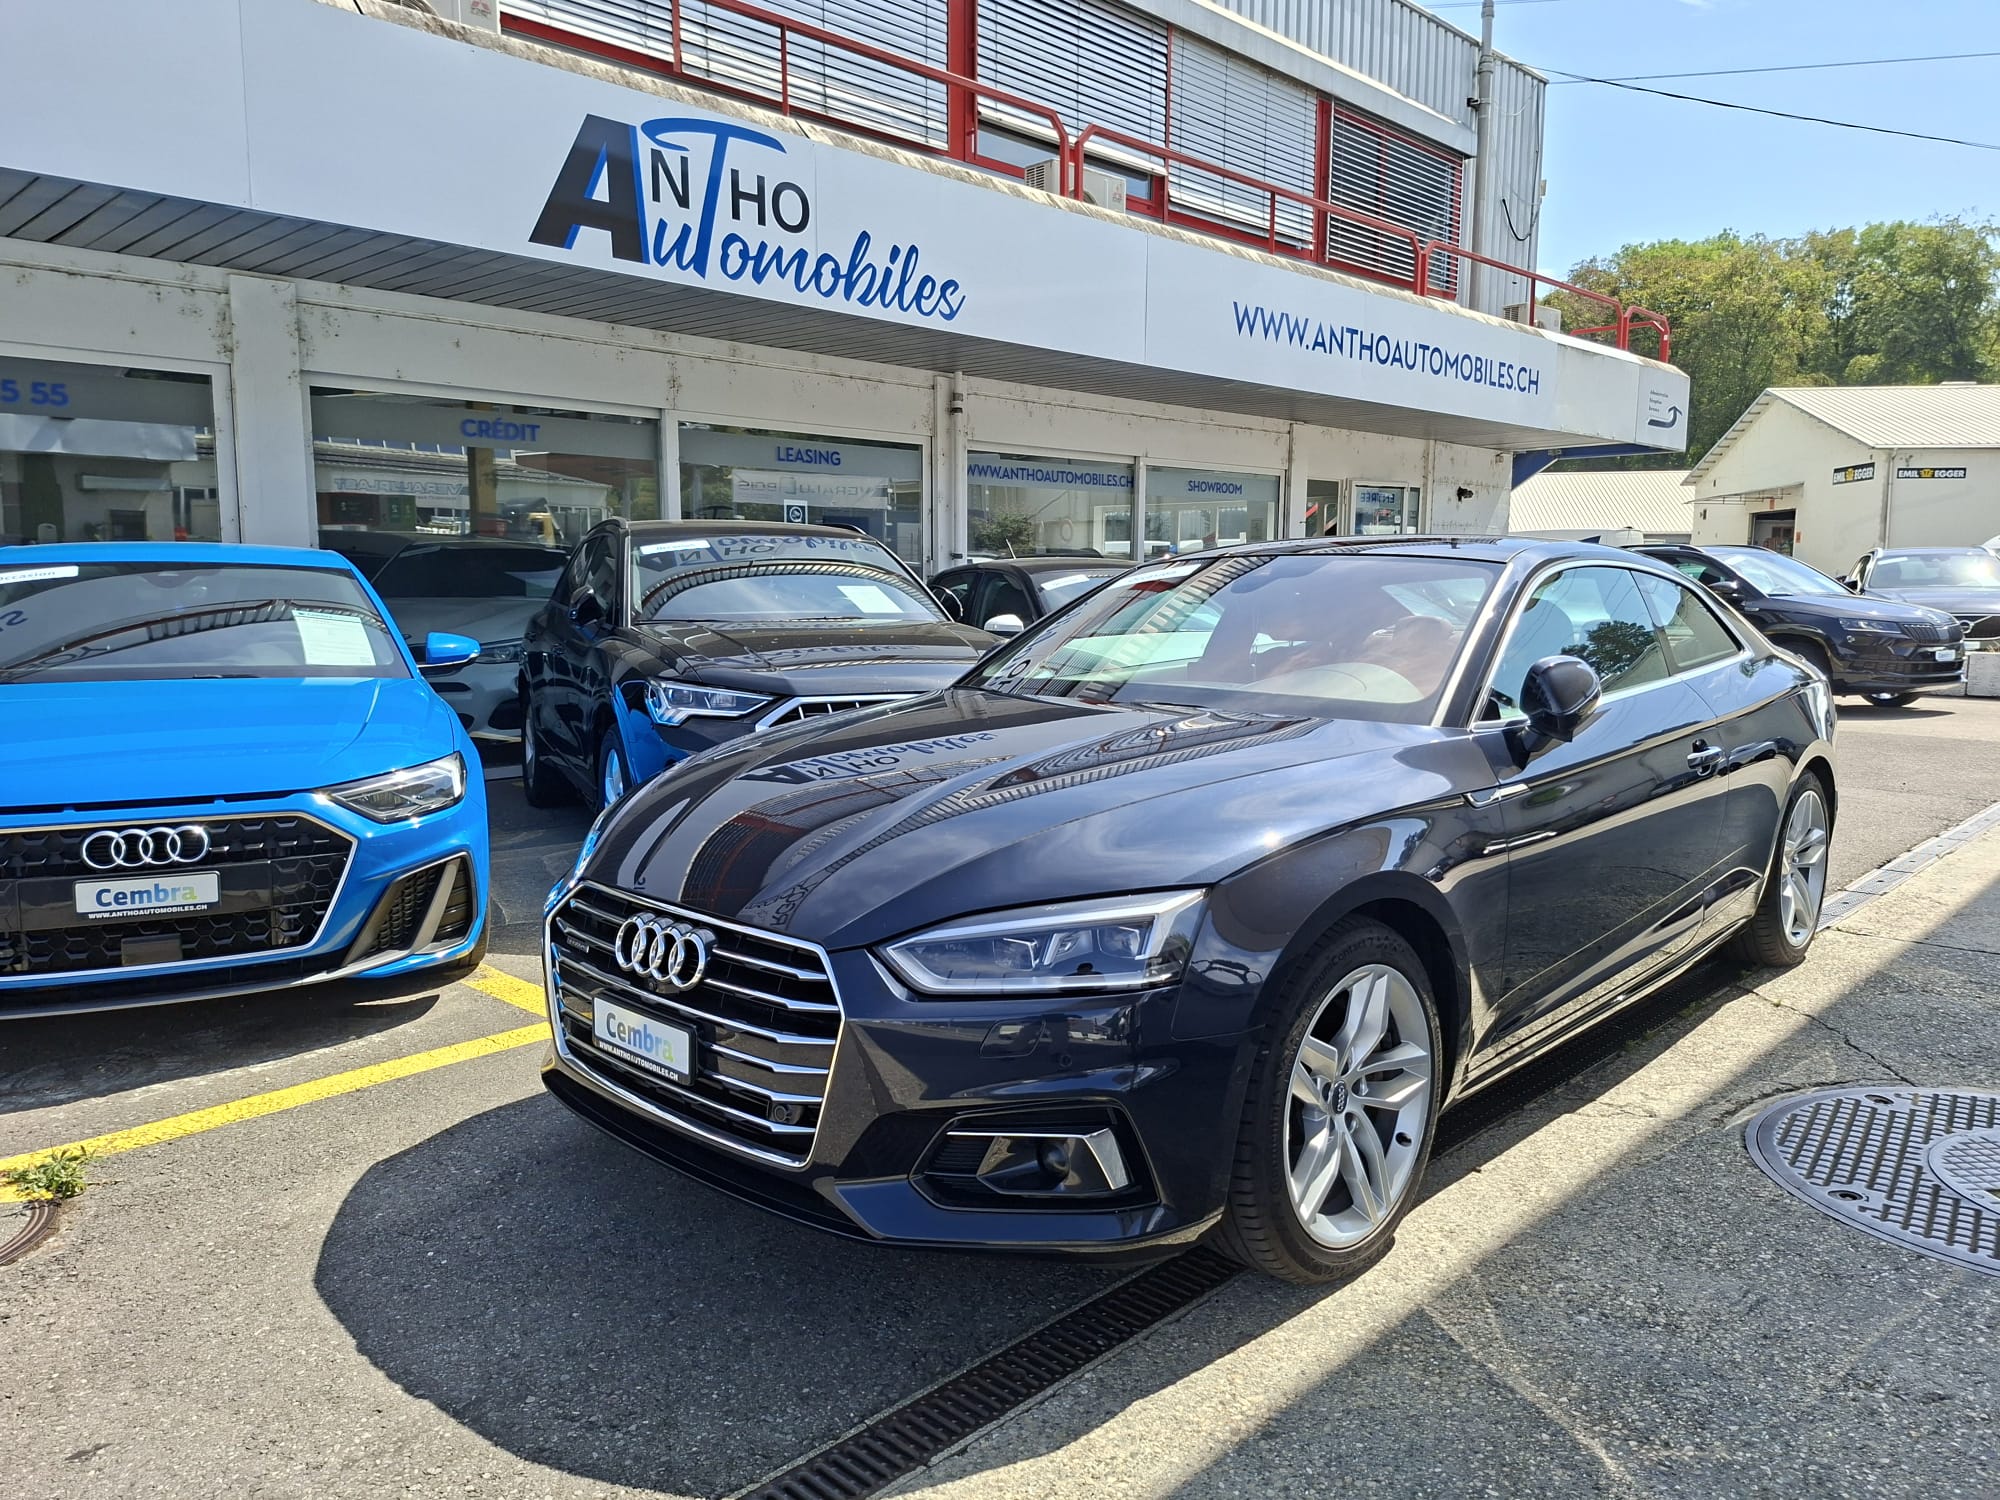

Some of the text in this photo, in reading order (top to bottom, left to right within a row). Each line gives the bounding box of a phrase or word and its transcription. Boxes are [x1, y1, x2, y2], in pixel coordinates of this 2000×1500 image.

[1233, 301, 1539, 395] WWW.ANTHOAUTOMOBILES.CH
[31, 381, 70, 407] 55
[461, 417, 541, 441] CRÉDIT
[777, 446, 841, 466] LEASING
[967, 464, 1134, 488] WWW.ANTHOAUTOMOBILES.CH
[1854, 467, 1873, 480] EGGER
[1899, 470, 1965, 478] EMIL EGGER
[1188, 480, 1242, 494] SHOWROOM
[96, 883, 197, 907] Cembra
[88, 904, 207, 919] WWW.ANTHOAUTOMOBILES.CH
[606, 1012, 675, 1063] Cembra
[599, 1041, 679, 1081] WWW.ANTHOAUTOMOBILES.CH
